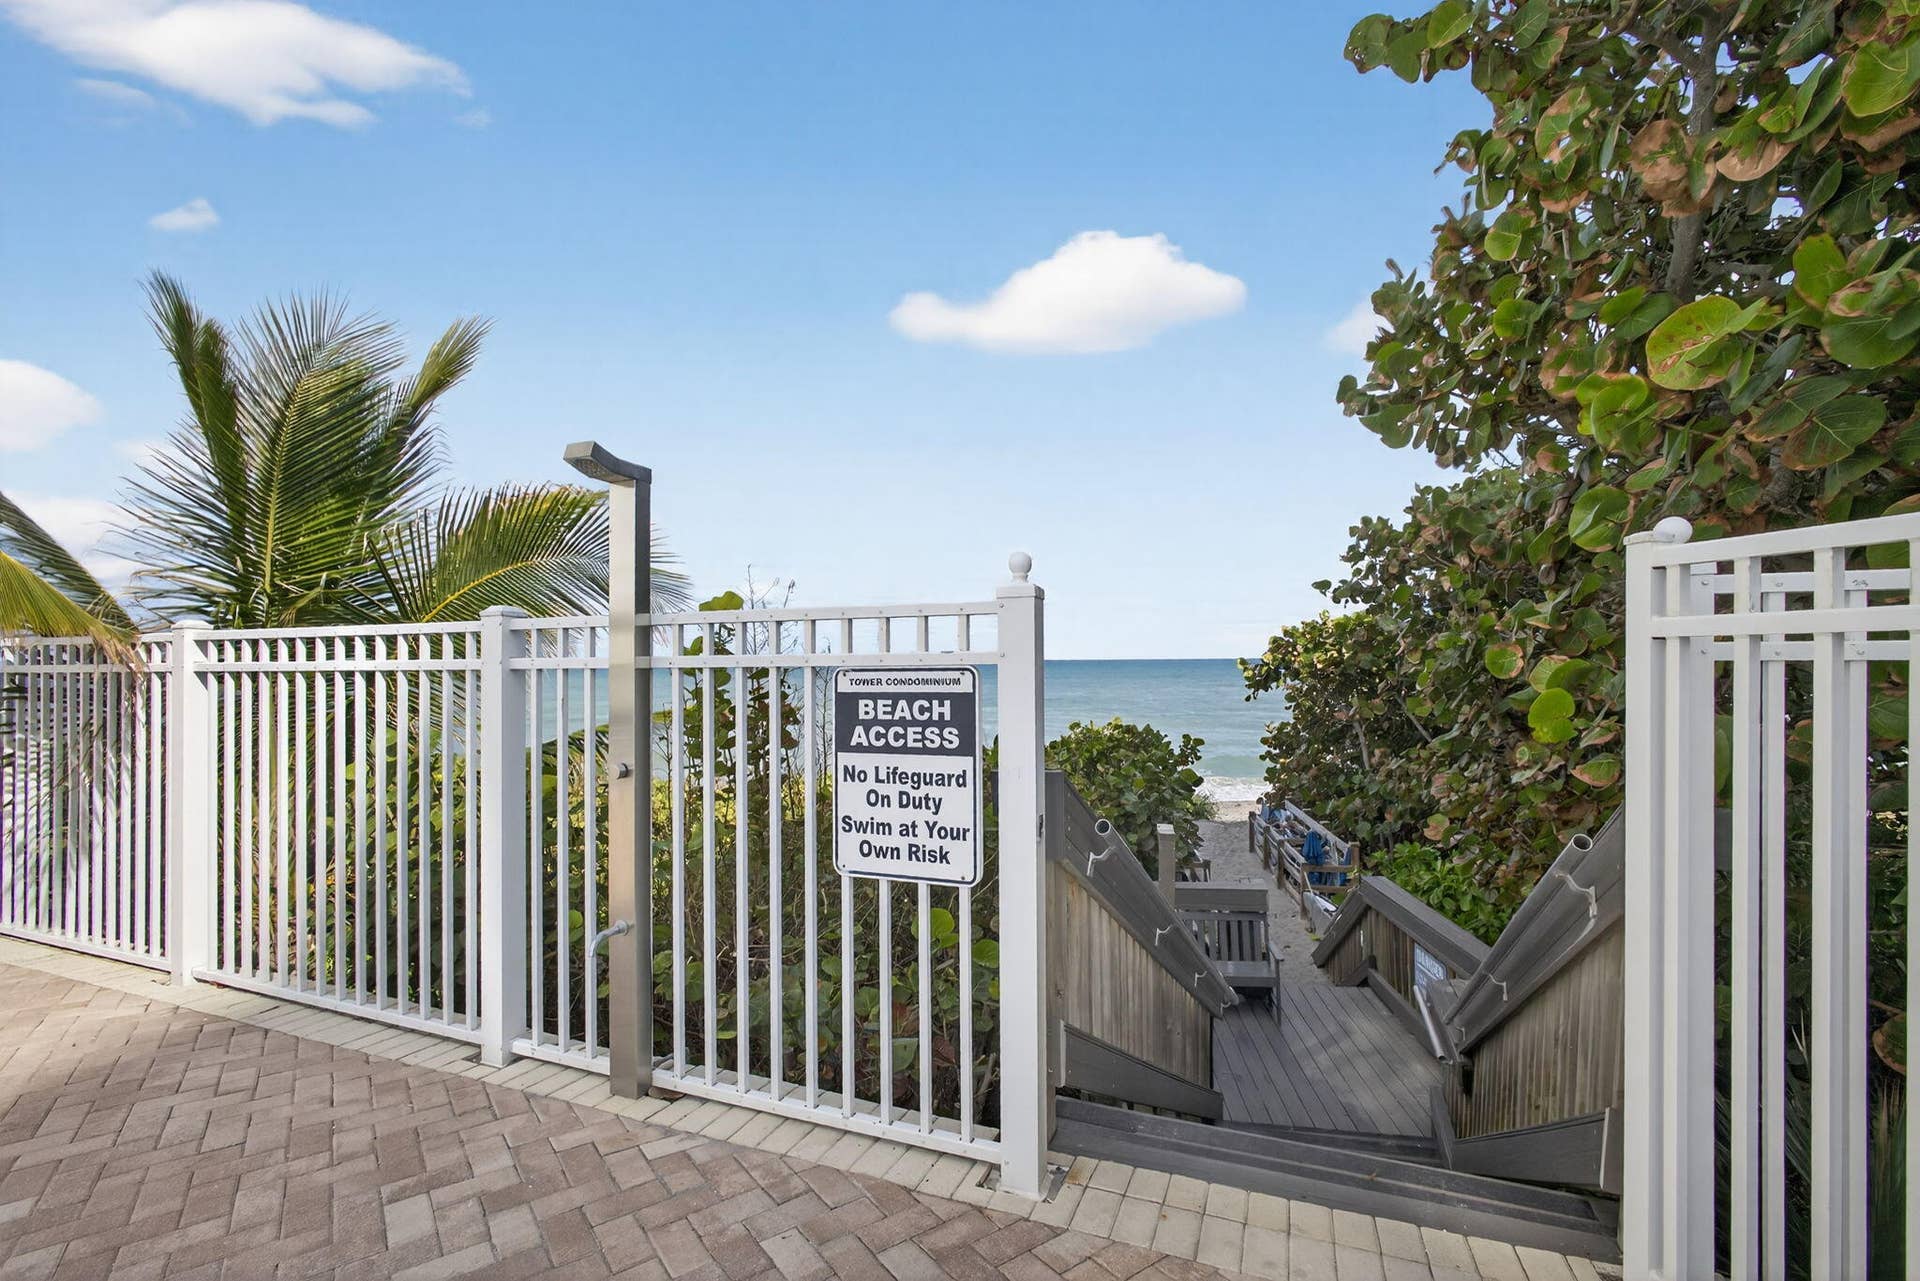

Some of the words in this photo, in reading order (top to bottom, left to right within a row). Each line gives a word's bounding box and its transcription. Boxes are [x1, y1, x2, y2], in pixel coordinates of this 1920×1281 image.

[849, 678, 883, 686] TOWER
[886, 678, 961, 686] CONDOMINIUM
[858, 699, 950, 721] BEACH
[850, 726, 960, 749] ACCESS
[843, 765, 867, 783] No
[874, 766, 967, 790] Lifeguard
[866, 789, 891, 808] On
[899, 791, 942, 815] Duty
[842, 816, 892, 836] Swim
[899, 821, 918, 837] at
[925, 821, 970, 841] Your
[859, 840, 900, 860] Own
[908, 844, 950, 864] Risk
